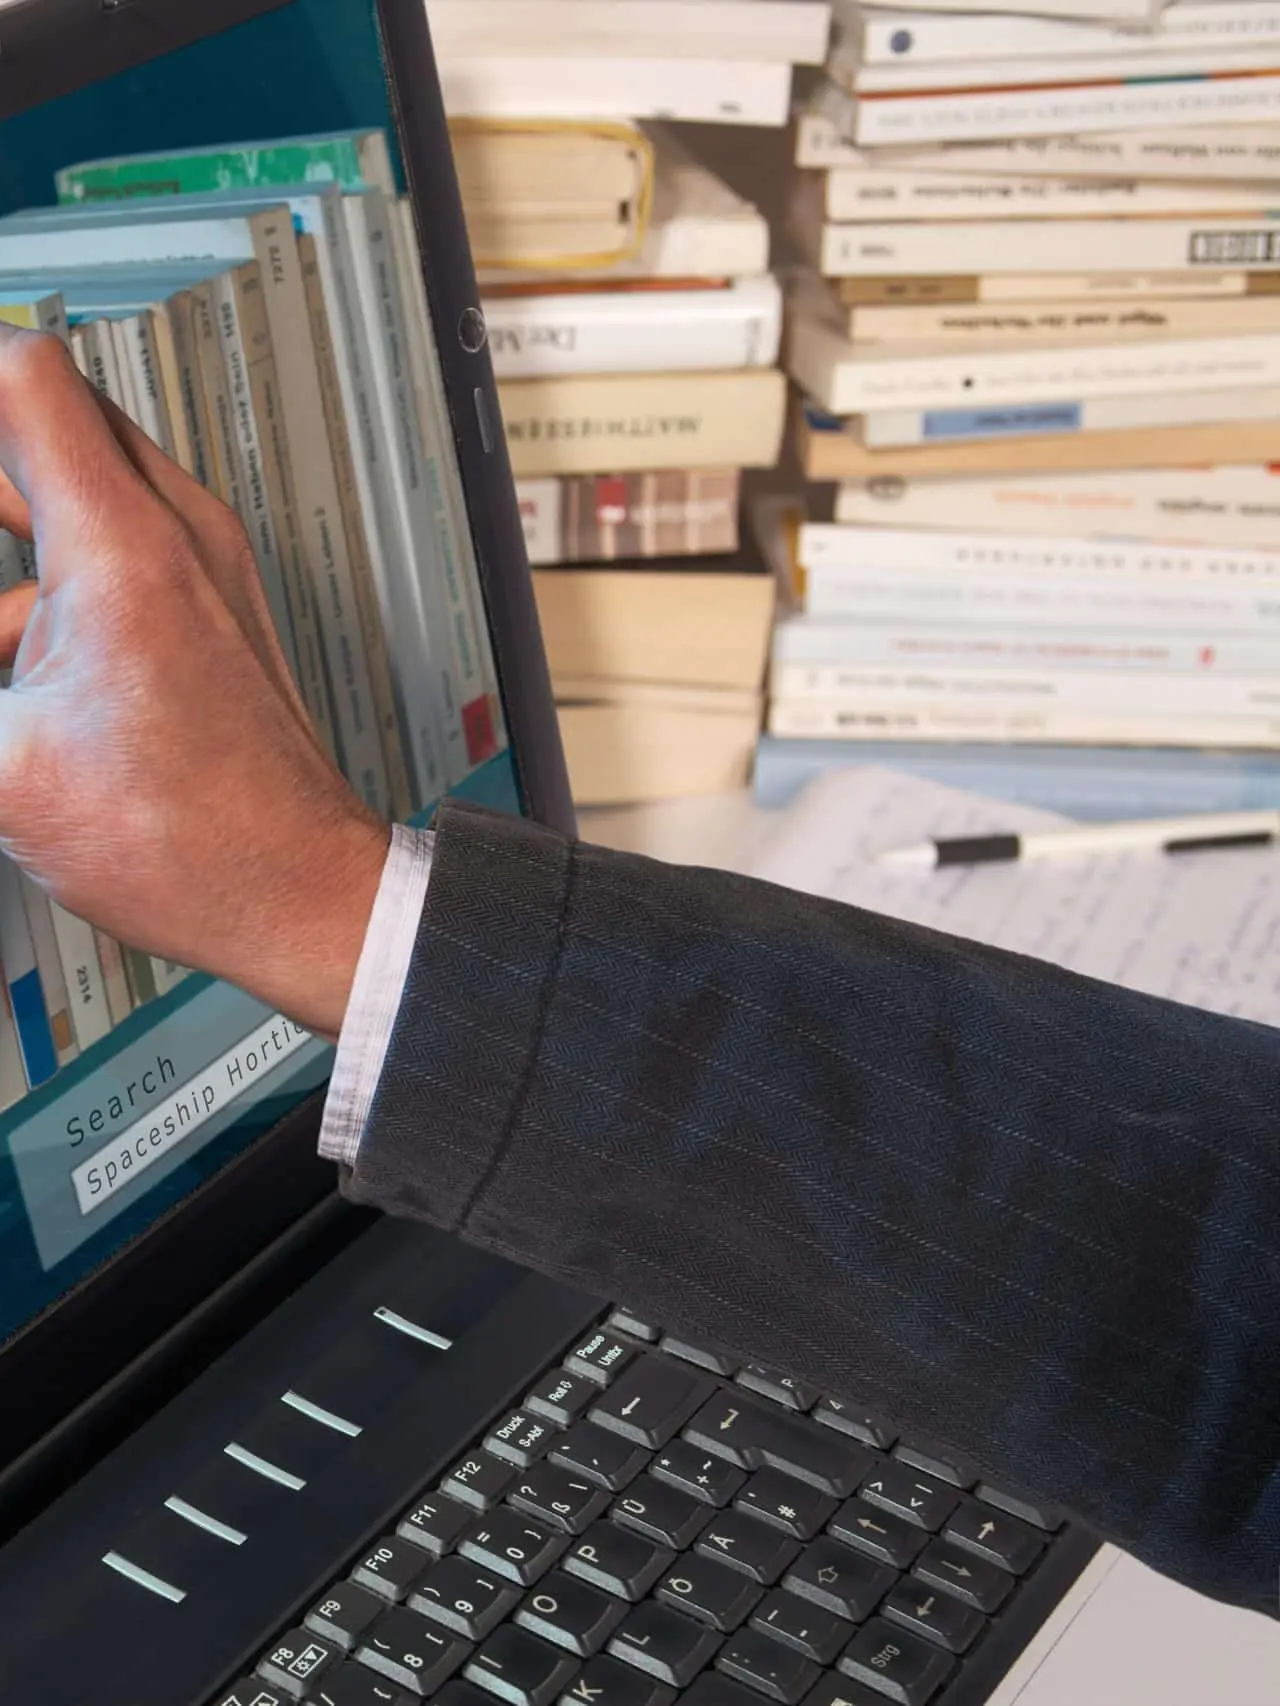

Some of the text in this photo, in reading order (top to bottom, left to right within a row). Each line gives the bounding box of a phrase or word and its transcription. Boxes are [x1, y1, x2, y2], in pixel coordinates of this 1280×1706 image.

[66, 1055, 177, 1148] Search
[87, 1083, 215, 1196] Spaceship
[576, 1334, 606, 1359] Pause
[548, 1383, 568, 1403] Roll
[496, 1414, 526, 1440] Druck
[454, 1460, 482, 1483] F12
[520, 1484, 538, 1498] ?
[410, 1503, 437, 1527] F11
[623, 1498, 647, 1515] Ü
[777, 1503, 796, 1520] #
[707, 1532, 736, 1551] Ä
[365, 1547, 394, 1572] F10
[576, 1544, 600, 1564] P
[669, 1576, 694, 1594] Ö
[319, 1599, 342, 1618] F9
[454, 1599, 475, 1614] 9
[622, 1631, 651, 1647] L
[271, 1646, 295, 1667] F8
[403, 1653, 424, 1669] 8
[870, 1643, 902, 1669] Strg
[572, 1679, 604, 1702] K
